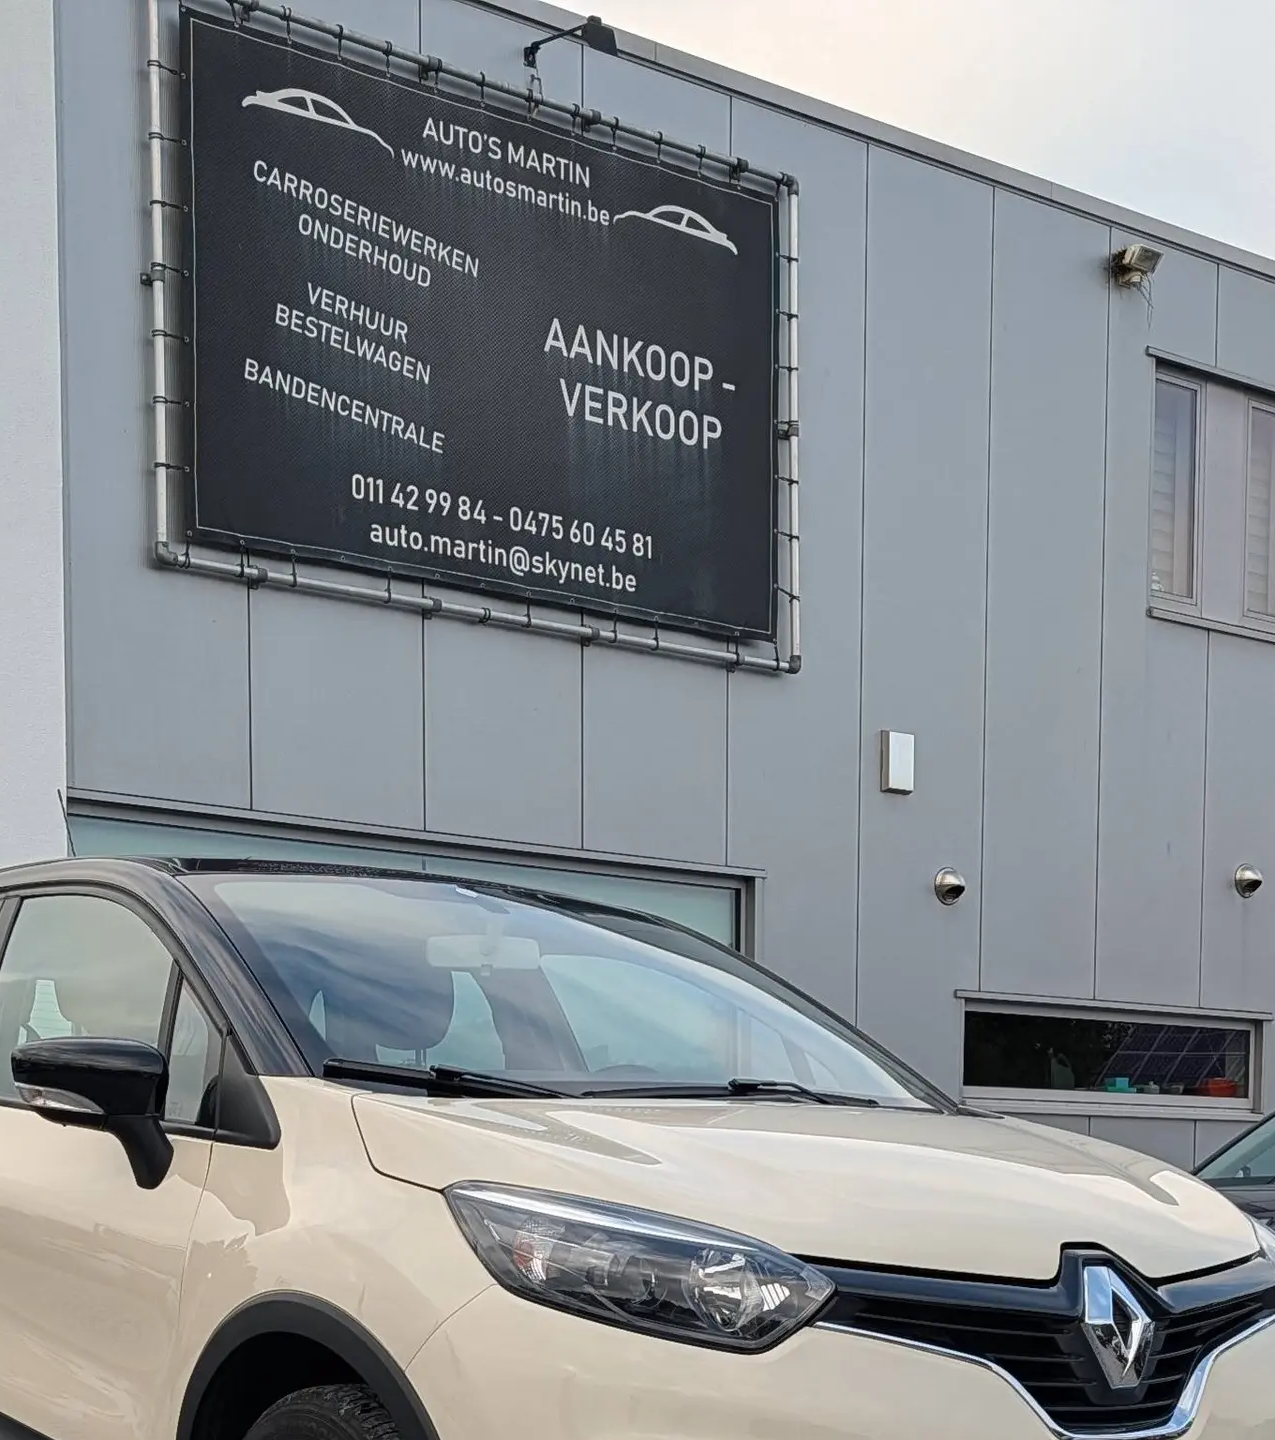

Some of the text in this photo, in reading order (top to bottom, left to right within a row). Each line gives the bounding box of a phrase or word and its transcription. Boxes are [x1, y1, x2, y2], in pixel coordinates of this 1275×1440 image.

[401, 148, 610, 226] www.autosmartin.be
[422, 117, 590, 189] AUTO'S MARTIN
[253, 160, 479, 278] CARROSERIEWERKEN
[298, 213, 431, 288] ONDERHOUD
[275, 303, 431, 385] BESTELWAGEN
[307, 282, 408, 345] VERHUUR
[244, 358, 445, 454] BANDENCENTRALE
[559, 377, 722, 450] VERKOOP
[351, 473, 384, 504] 011
[390, 482, 419, 511] 42
[425, 488, 452, 517] 99
[458, 495, 487, 525] 84
[509, 506, 564, 540] 0475
[569, 519, 595, 546] 60
[600, 526, 627, 554] 45
[632, 532, 652, 559] 81
[370, 523, 637, 592] auto.martin@skynet.be
